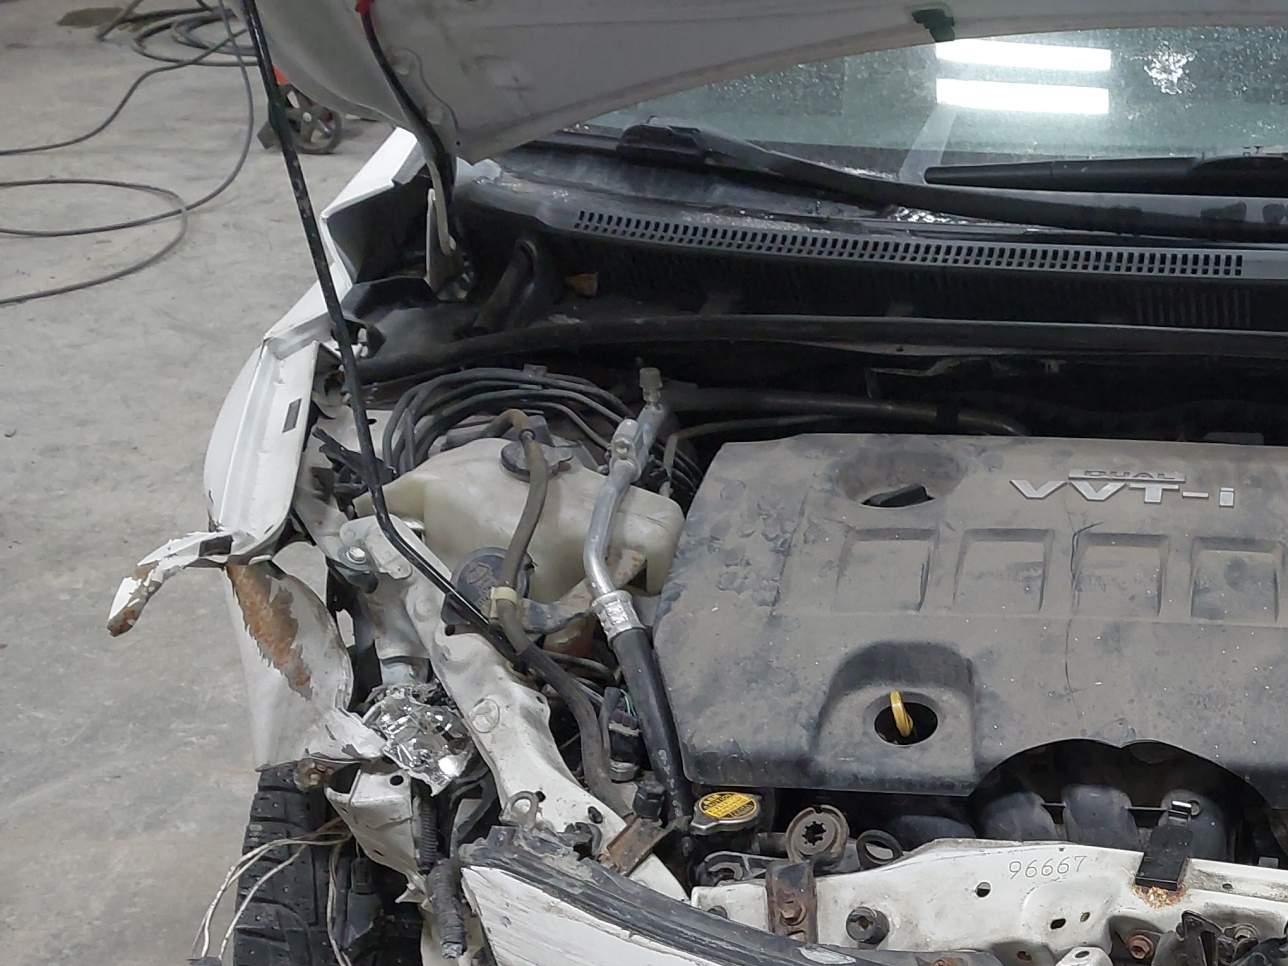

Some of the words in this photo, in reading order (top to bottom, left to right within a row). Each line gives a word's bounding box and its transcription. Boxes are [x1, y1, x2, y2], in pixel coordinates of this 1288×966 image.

[1081, 469, 1177, 481] DUAL
[1009, 479, 1235, 508] VVT-i
[1008, 855, 1087, 880] 96667
